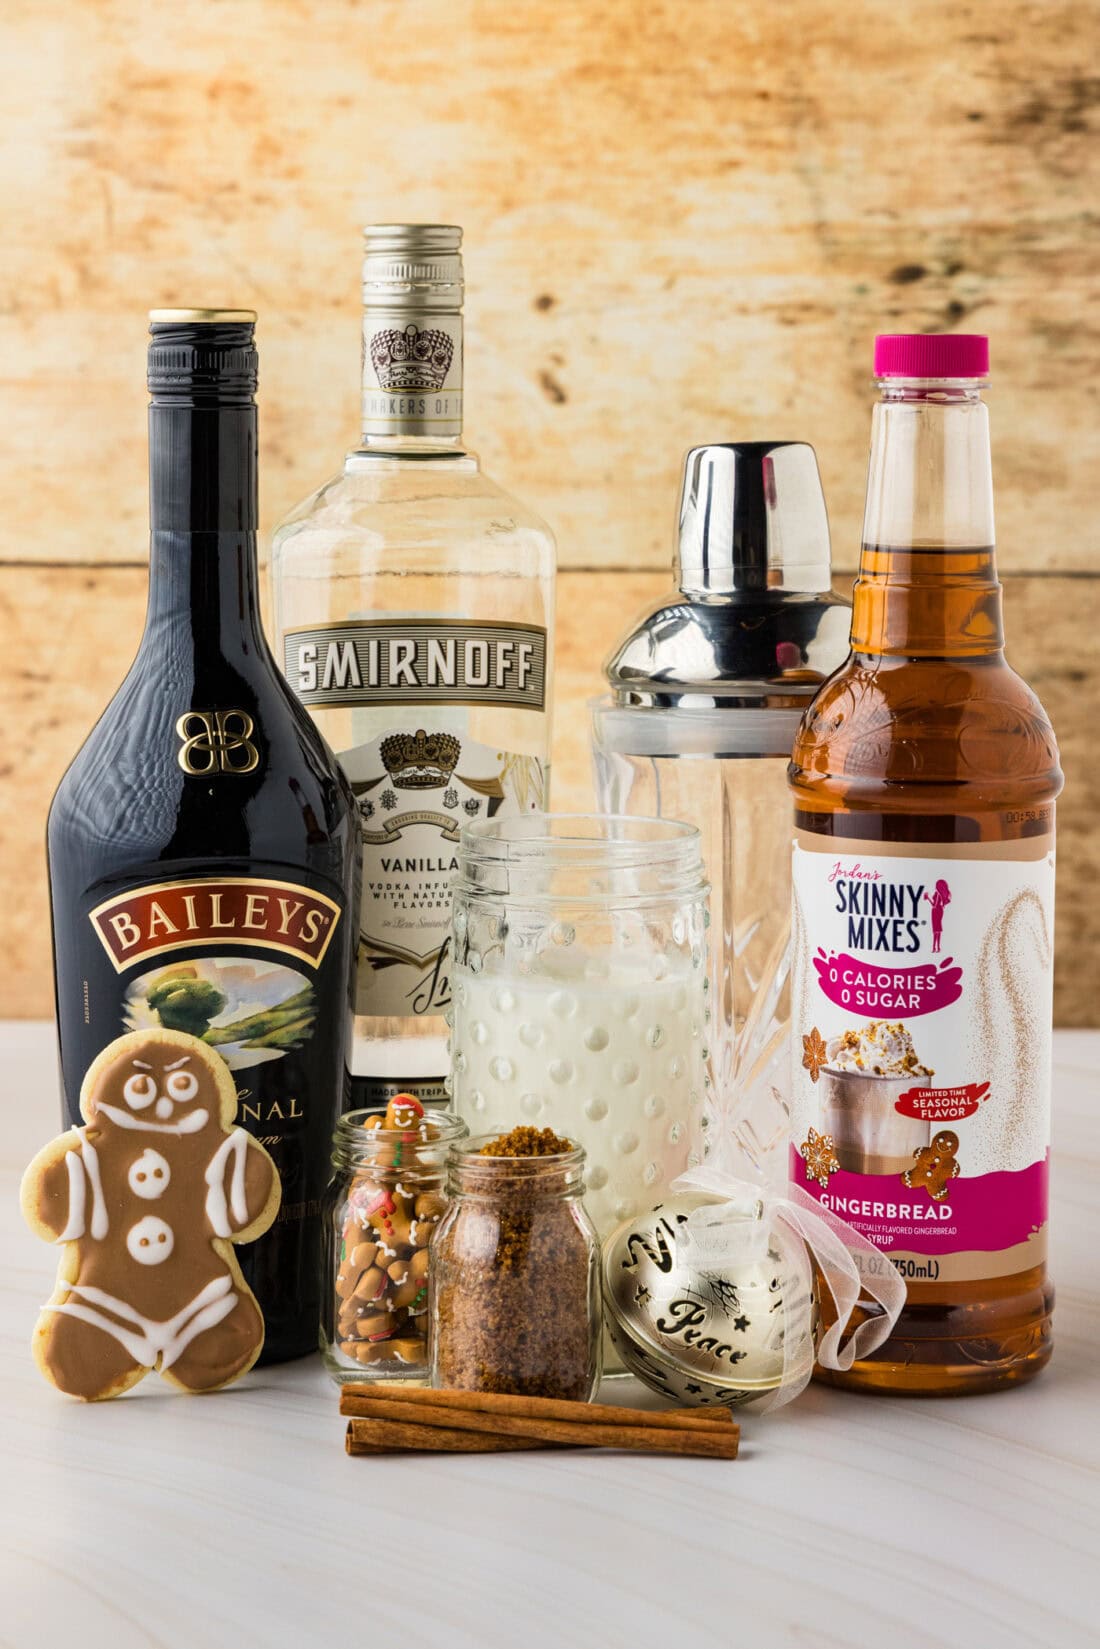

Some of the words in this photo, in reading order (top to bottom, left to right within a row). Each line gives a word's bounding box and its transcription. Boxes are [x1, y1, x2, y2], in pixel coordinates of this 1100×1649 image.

[435, 399, 449, 414] OF
[298, 639, 533, 692] SMIRNOFF
[380, 857, 460, 872] VANILLA
[828, 861, 883, 883] Jordan's
[369, 882, 410, 891] VODKA
[419, 882, 449, 890] INFU
[373, 892, 404, 900] WITH
[413, 891, 453, 899] NATUR
[836, 879, 925, 919] SKINNY
[393, 900, 451, 909] FLAVORS
[108, 893, 326, 951] BAILEYS
[847, 915, 921, 953] MIXES
[829, 968, 839, 983] 0
[842, 971, 937, 991] CALORIES
[841, 989, 851, 1004] 0
[855, 990, 921, 1009] SUGAR
[371, 1087, 395, 1097] MADE
[421, 1086, 447, 1097] TRIPL
[918, 1090, 948, 1098] LIMITED
[949, 1088, 967, 1097] TIME
[912, 1096, 973, 1109] SEASONAL
[921, 1107, 966, 1119] FLAVOR
[819, 1193, 953, 1221] GINGERBREAD
[881, 1224, 914, 1235] FLAVORED
[914, 1227, 958, 1236] GINGERBREAD
[866, 1233, 894, 1246] SYRUP
[656, 1299, 748, 1365] Peace
